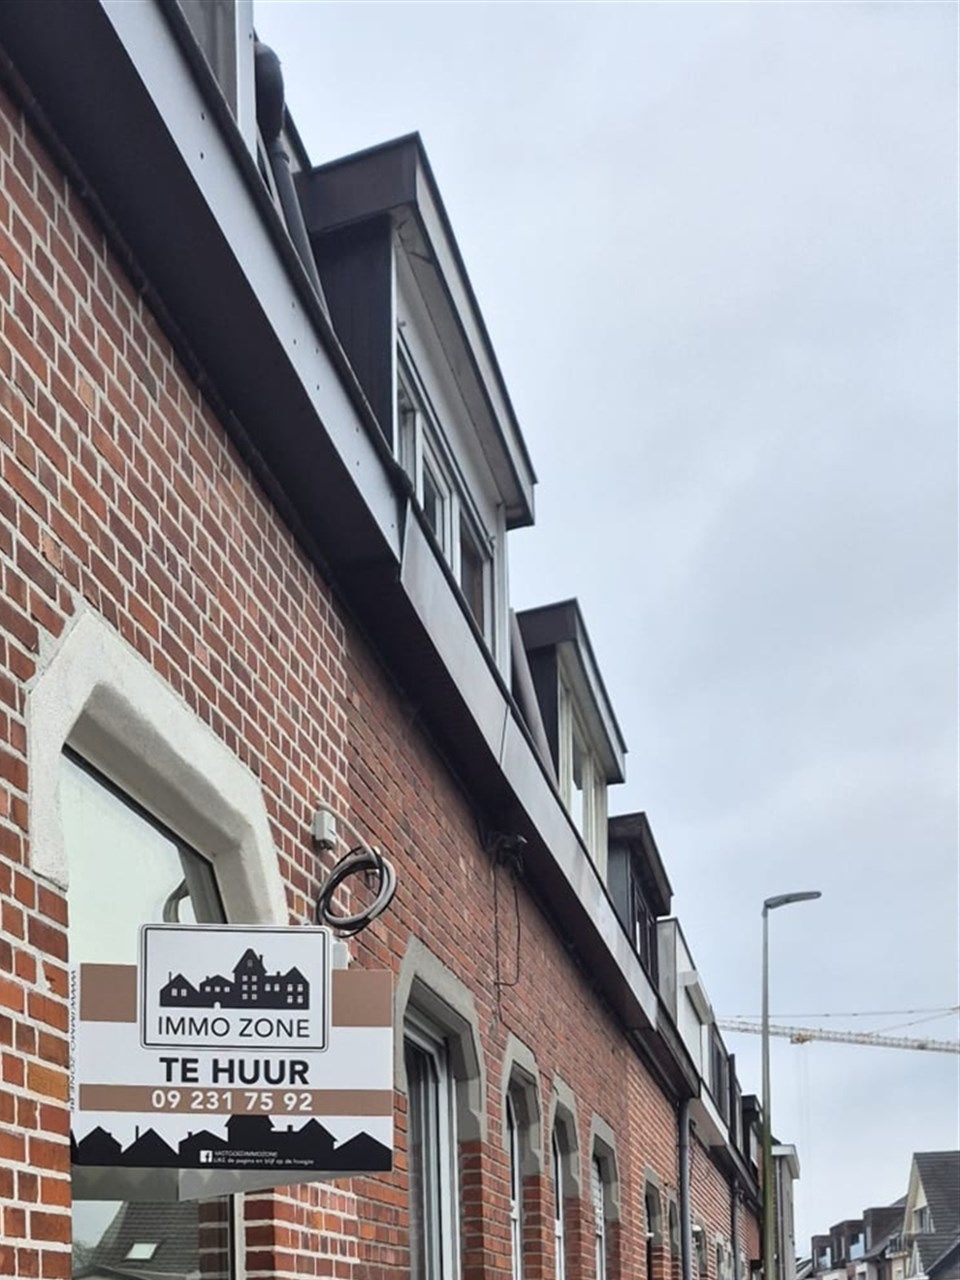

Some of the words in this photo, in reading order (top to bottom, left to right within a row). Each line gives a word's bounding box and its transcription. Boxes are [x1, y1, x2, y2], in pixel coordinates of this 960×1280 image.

[158, 1016, 230, 1037] IMMO
[238, 1017, 310, 1038] ZONE
[159, 1056, 199, 1083] TE
[212, 1058, 309, 1085] HUUR
[151, 1089, 181, 1109] 09
[190, 1090, 232, 1110] 231
[244, 1091, 273, 1111] 75
[283, 1092, 313, 1112] 92
